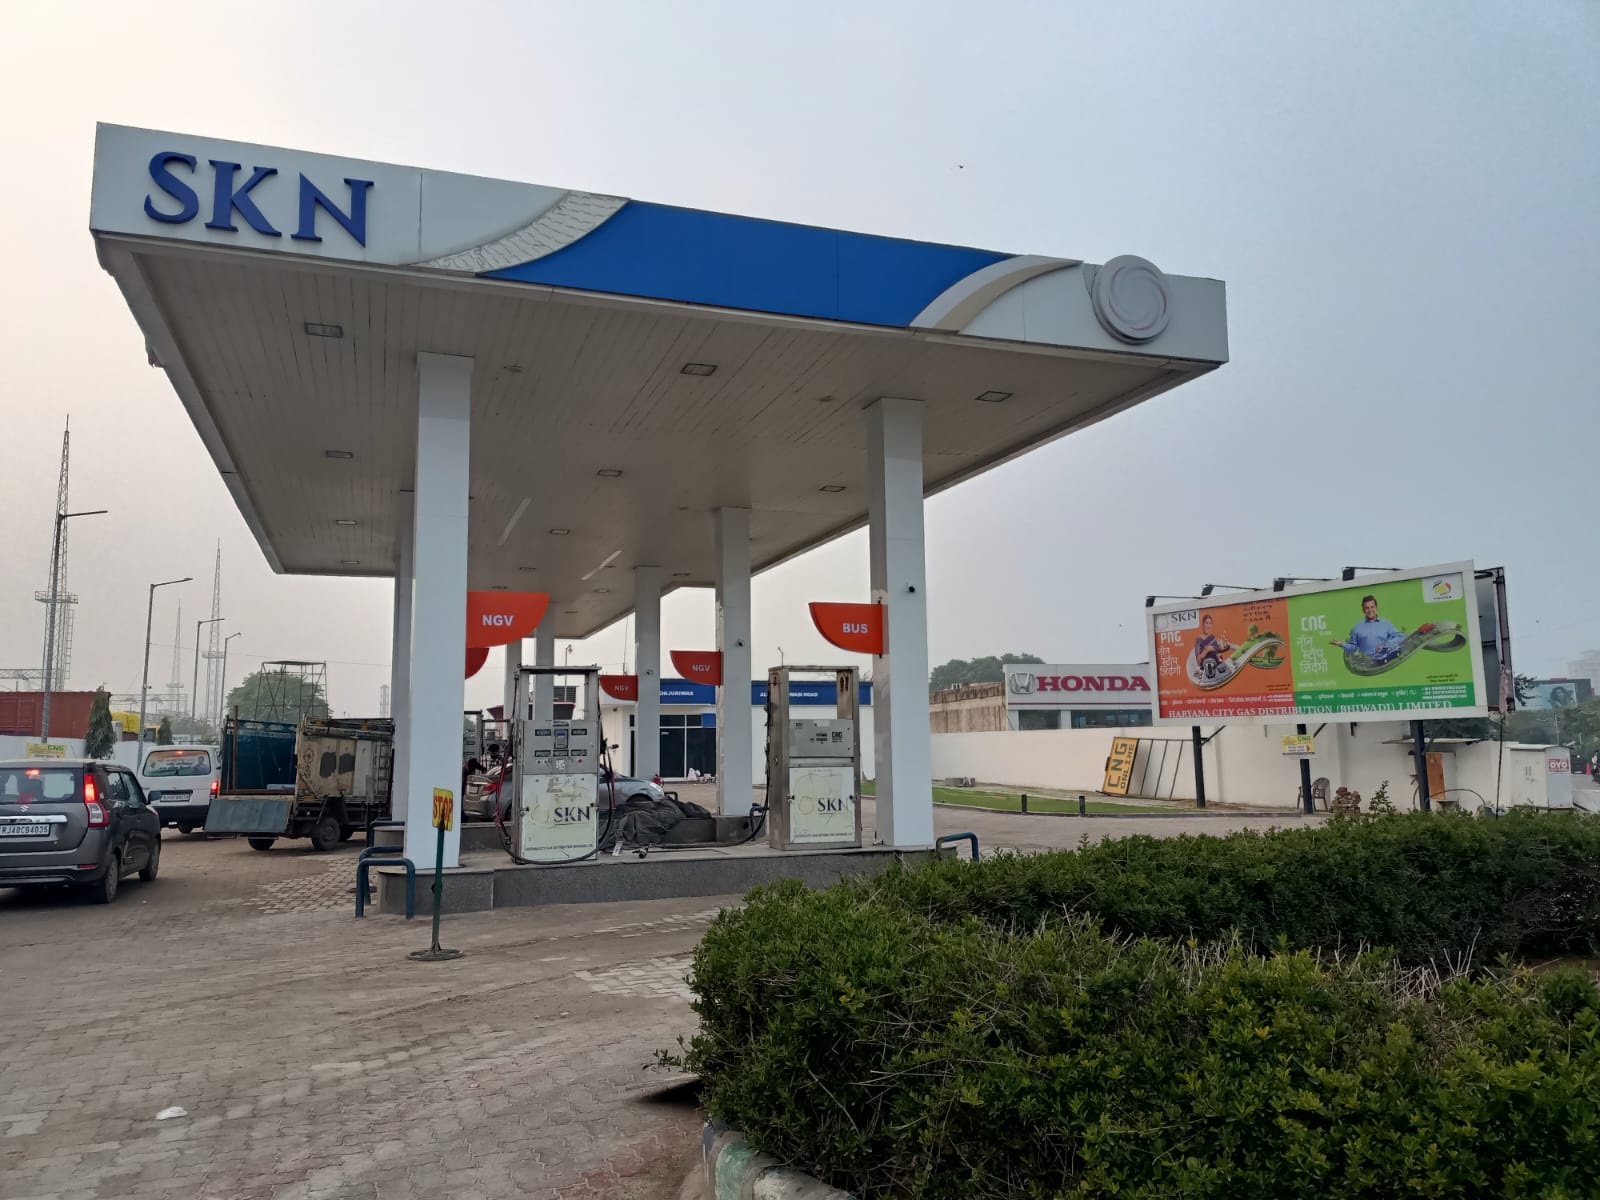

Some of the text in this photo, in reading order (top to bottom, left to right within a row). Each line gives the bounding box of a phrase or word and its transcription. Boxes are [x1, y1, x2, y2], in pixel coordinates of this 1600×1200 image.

[144, 151, 374, 248] SKN
[482, 614, 514, 626] NGV
[1171, 611, 1197, 623] SKN
[1301, 615, 1327, 631] CNG
[842, 623, 868, 634] BUS
[1160, 631, 1181, 643] PNG
[692, 664, 711, 672] NGV
[1036, 676, 1152, 692] HONDA
[1168, 709, 1210, 718] HARYANA
[1212, 708, 1233, 717] CITY
[1236, 706, 1256, 716] GAS
[1258, 704, 1333, 716] DISTRIBUTION
[1398, 700, 1453, 711] LIMITED
[1107, 742, 1128, 788] CNG
[1120, 743, 1135, 789] ONLINE
[1549, 761, 1568, 769] OYO
[433, 795, 454, 822] STOP
[553, 806, 591, 823] SKN
